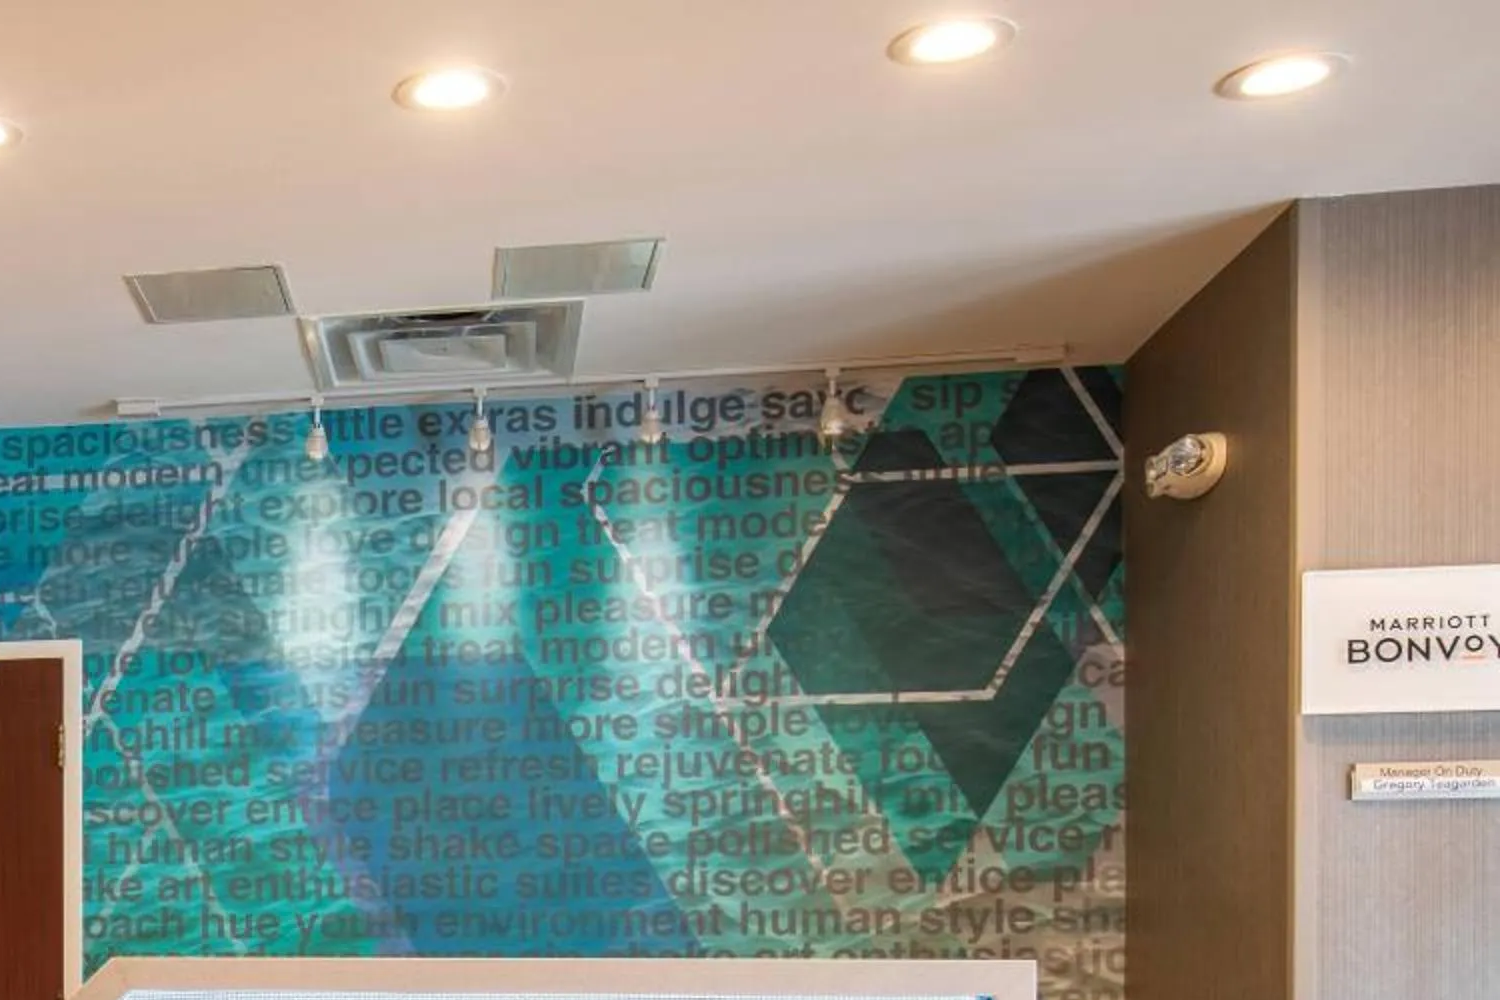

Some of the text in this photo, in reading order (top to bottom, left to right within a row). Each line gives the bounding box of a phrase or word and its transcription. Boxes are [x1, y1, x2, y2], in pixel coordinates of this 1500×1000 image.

[1, 417, 295, 468] spaciousness
[418, 402, 558, 442] exras
[911, 380, 983, 418] sip
[64, 458, 223, 494] modern
[242, 438, 494, 487] unexpected
[509, 432, 670, 471] vibrant
[103, 489, 244, 533] delight
[260, 482, 424, 527] explore
[439, 475, 543, 512] local
[28, 538, 130, 569] more
[410, 513, 559, 558] dsign
[576, 511, 679, 546] treat
[568, 546, 760, 595] surprise
[536, 590, 734, 633] pleasure
[1369, 614, 1491, 631] MARRIOTT
[540, 626, 715, 663] modern
[454, 664, 640, 712] surprise
[521, 711, 638, 744] more
[654, 700, 808, 748] simple
[439, 748, 598, 783] refresh
[617, 741, 858, 789] rejuvenate
[1033, 737, 1111, 771] fun
[1379, 765, 1484, 779] Manager On Duty
[394, 785, 511, 832] place
[528, 784, 647, 832] lively
[108, 832, 253, 865] human
[269, 828, 373, 867] style
[388, 825, 521, 862] shake
[536, 830, 671, 868] space
[687, 816, 890, 868] polished
[228, 863, 499, 902] enthusiastic
[516, 863, 650, 899] suites
[668, 862, 873, 899] discover
[888, 857, 1035, 894] entice
[202, 902, 280, 940] hue
[435, 902, 722, 939] environment
[741, 900, 900, 936] human
[920, 898, 1035, 943] style
